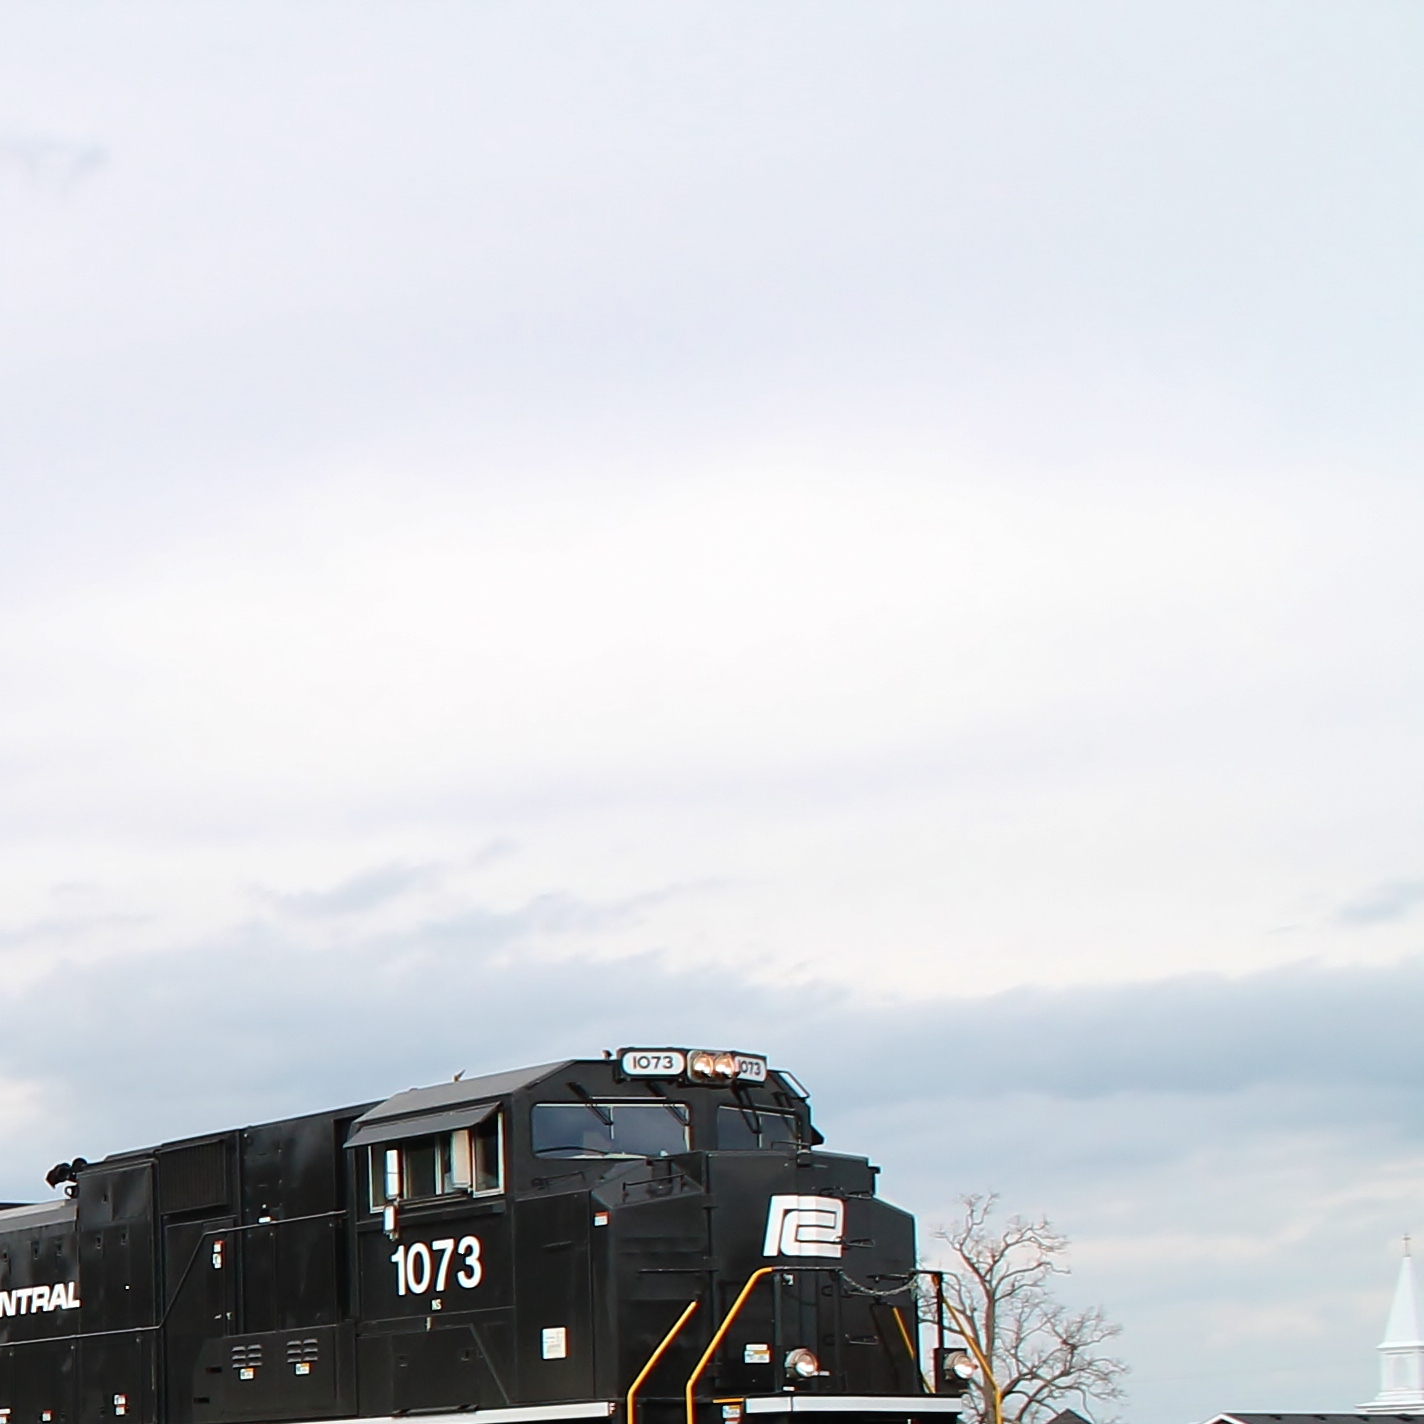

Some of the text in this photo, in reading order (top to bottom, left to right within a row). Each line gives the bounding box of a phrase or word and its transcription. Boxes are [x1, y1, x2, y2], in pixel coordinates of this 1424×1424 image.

[633, 1056, 674, 1070] 1073
[738, 1059, 762, 1076] 1073
[391, 1235, 482, 1296] 1073
